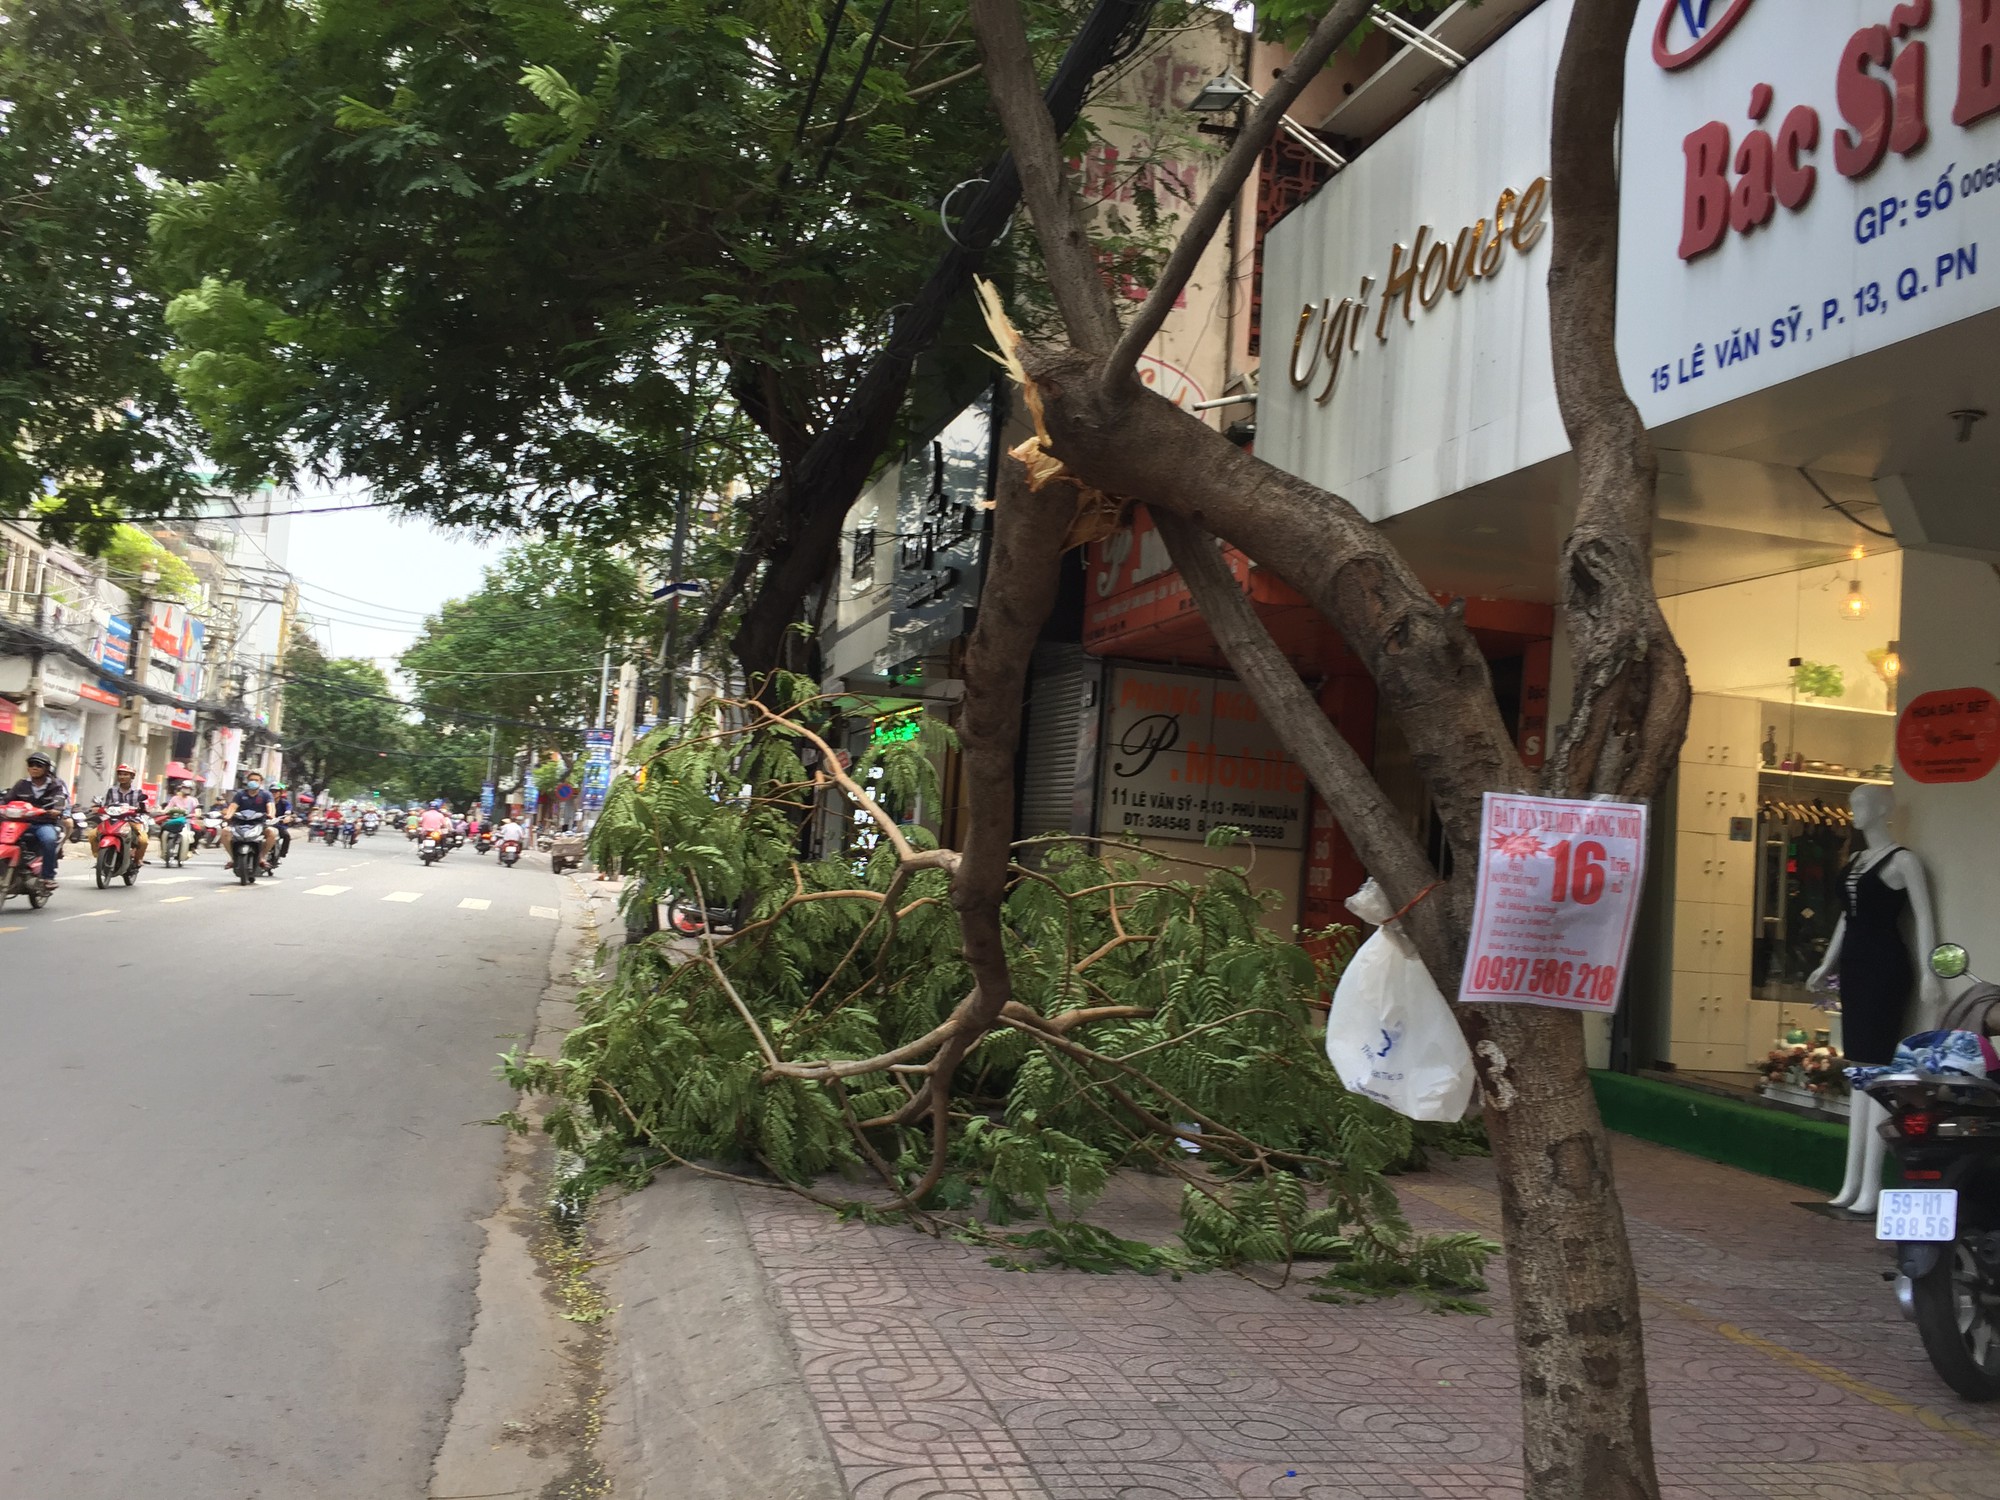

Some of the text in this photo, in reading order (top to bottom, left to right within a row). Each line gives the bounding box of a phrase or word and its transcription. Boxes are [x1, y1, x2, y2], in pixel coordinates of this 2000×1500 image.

[1678, 83, 1819, 260] Bác
[1833, 0, 1930, 178] Sĩ
[1855, 196, 1909, 245] GP:
[1376, 176, 1551, 342] House
[1650, 363, 1671, 393] 15
[1678, 343, 1706, 384] LÊ
[1715, 327, 1761, 368] VĂN
[1822, 298, 1845, 330] P.
[1854, 282, 1887, 317] 13,
[1896, 266, 1928, 301] Q.
[1936, 243, 1978, 287] PN
[1111, 787, 1128, 805] 11
[1132, 790, 1146, 808] LÊ
[1150, 792, 1175, 811] VĂN
[1547, 840, 1607, 905] 16
[1474, 955, 1617, 1001] 0937 586 218
[1883, 1216, 1950, 1238] 588.56
